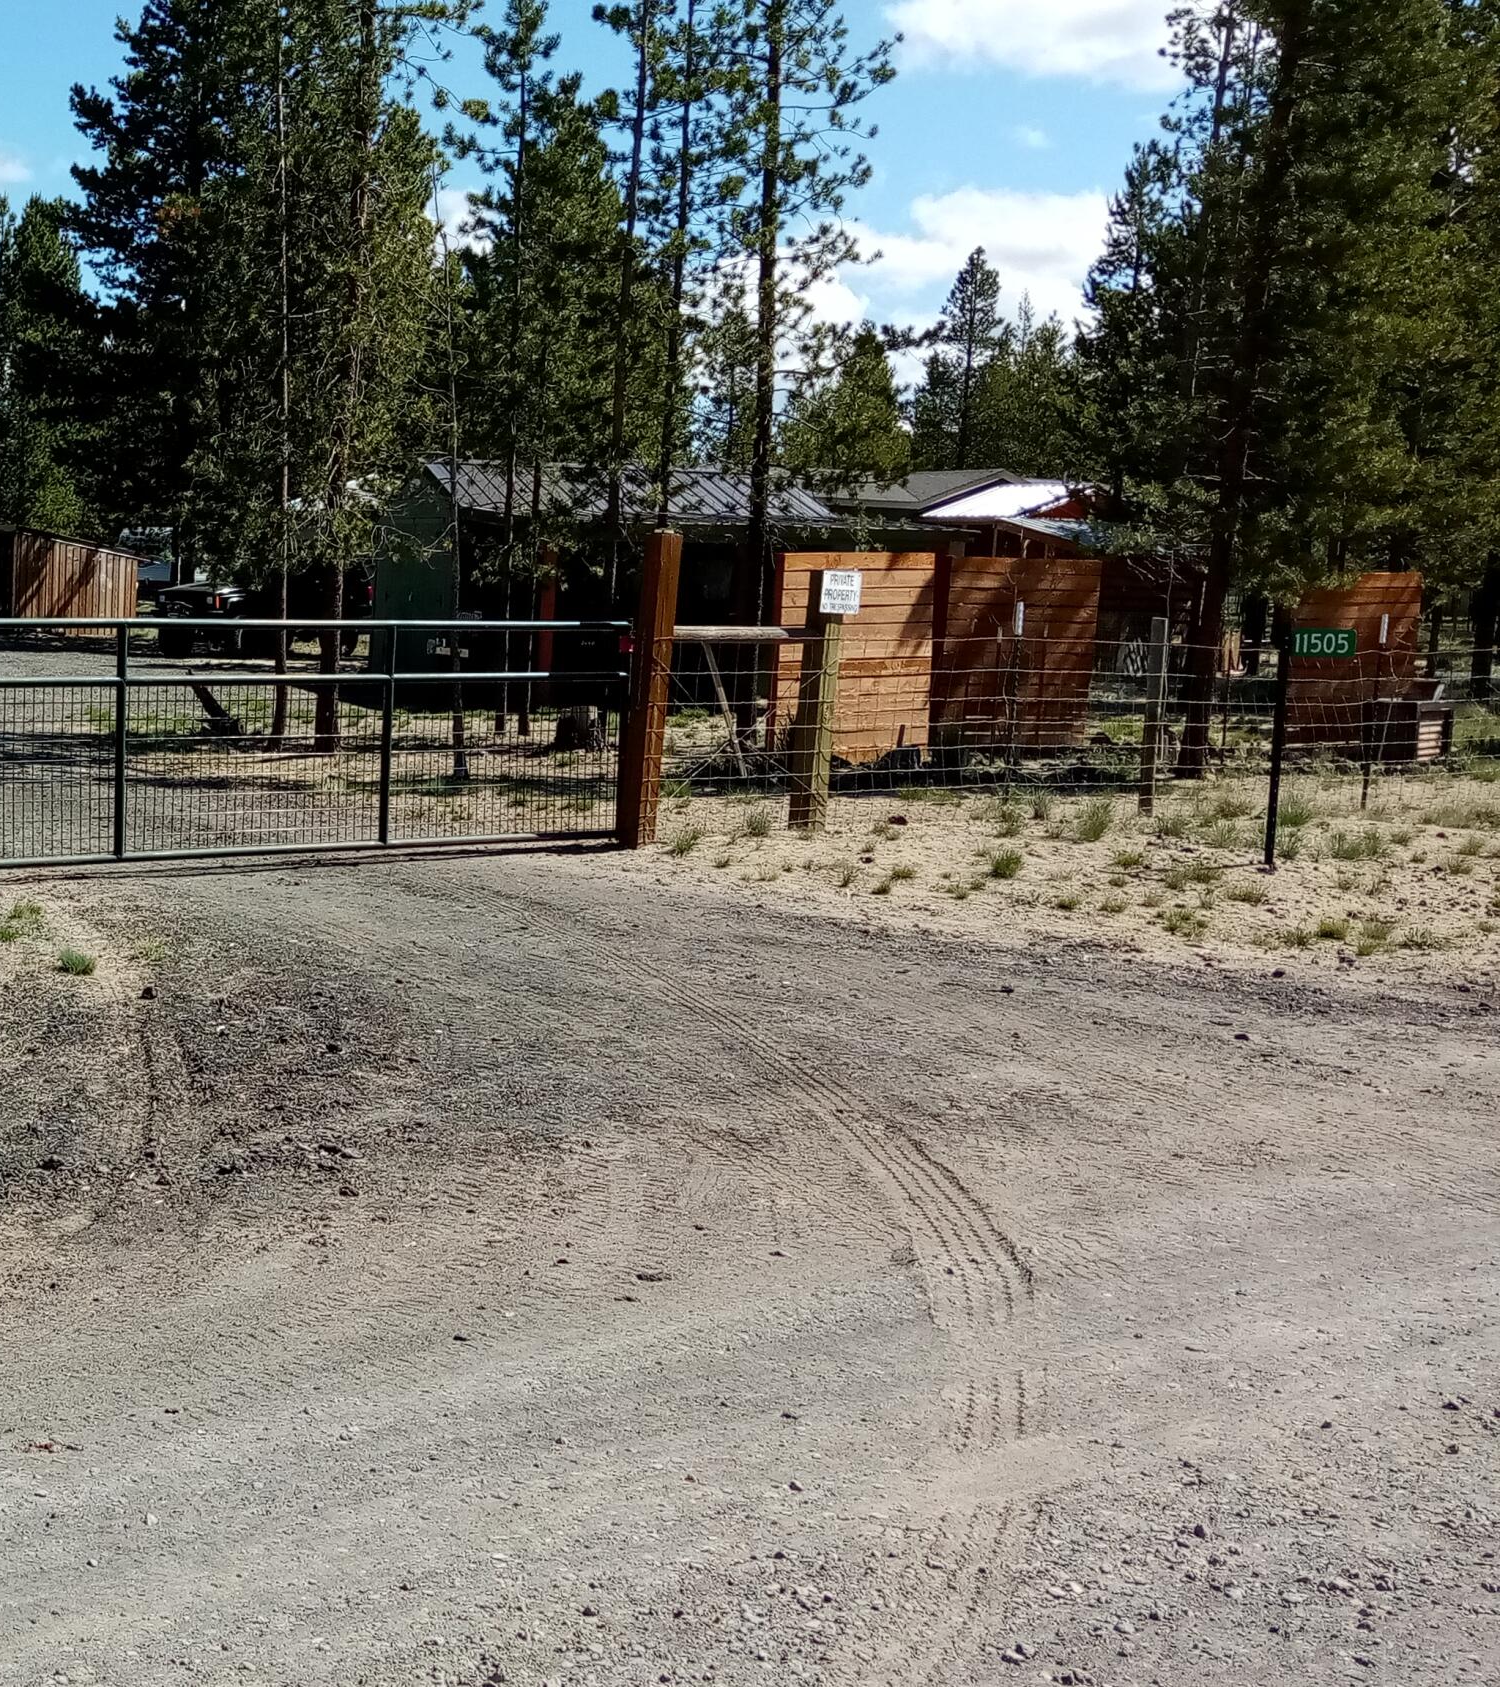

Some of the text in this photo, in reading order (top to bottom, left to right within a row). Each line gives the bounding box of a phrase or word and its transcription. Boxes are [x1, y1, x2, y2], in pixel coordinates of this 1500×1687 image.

[830, 574, 854, 586] PRIVATE
[824, 588, 857, 602] PROPERTY
[1295, 633, 1349, 653] 11505
